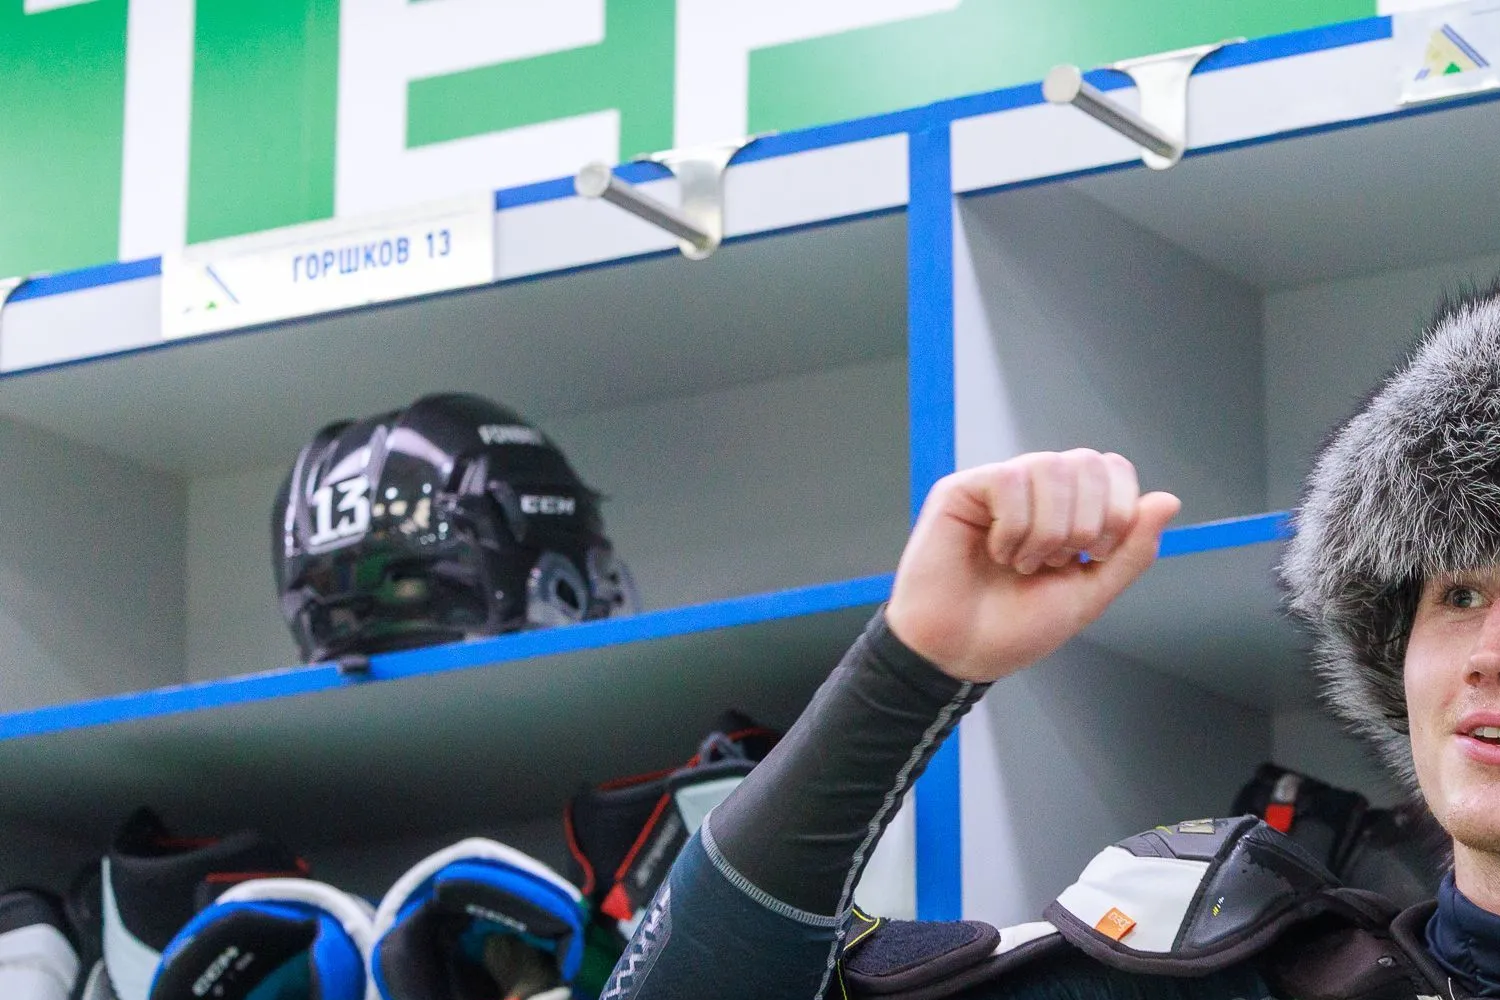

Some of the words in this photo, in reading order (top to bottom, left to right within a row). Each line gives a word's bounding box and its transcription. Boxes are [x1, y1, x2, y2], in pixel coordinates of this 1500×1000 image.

[292, 237, 410, 283] ГОРШКОВ
[426, 229, 452, 259] 13
[310, 474, 371, 548] 13
